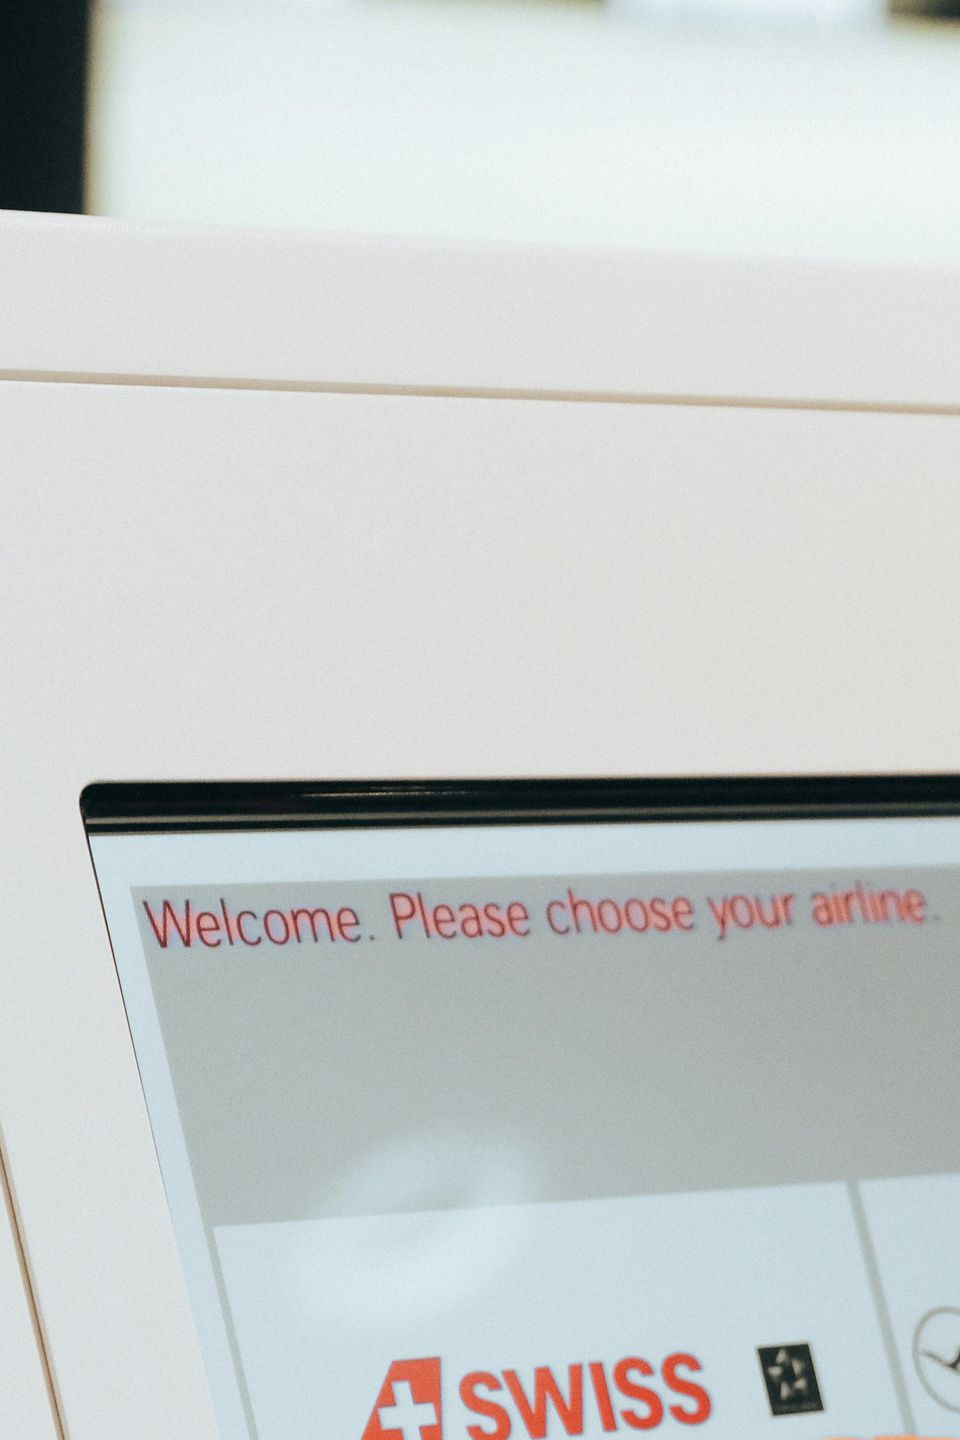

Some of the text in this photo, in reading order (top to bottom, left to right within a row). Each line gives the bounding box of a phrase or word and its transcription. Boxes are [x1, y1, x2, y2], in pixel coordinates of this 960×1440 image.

[143, 881, 941, 948] Welcome. Please choose your airline.
